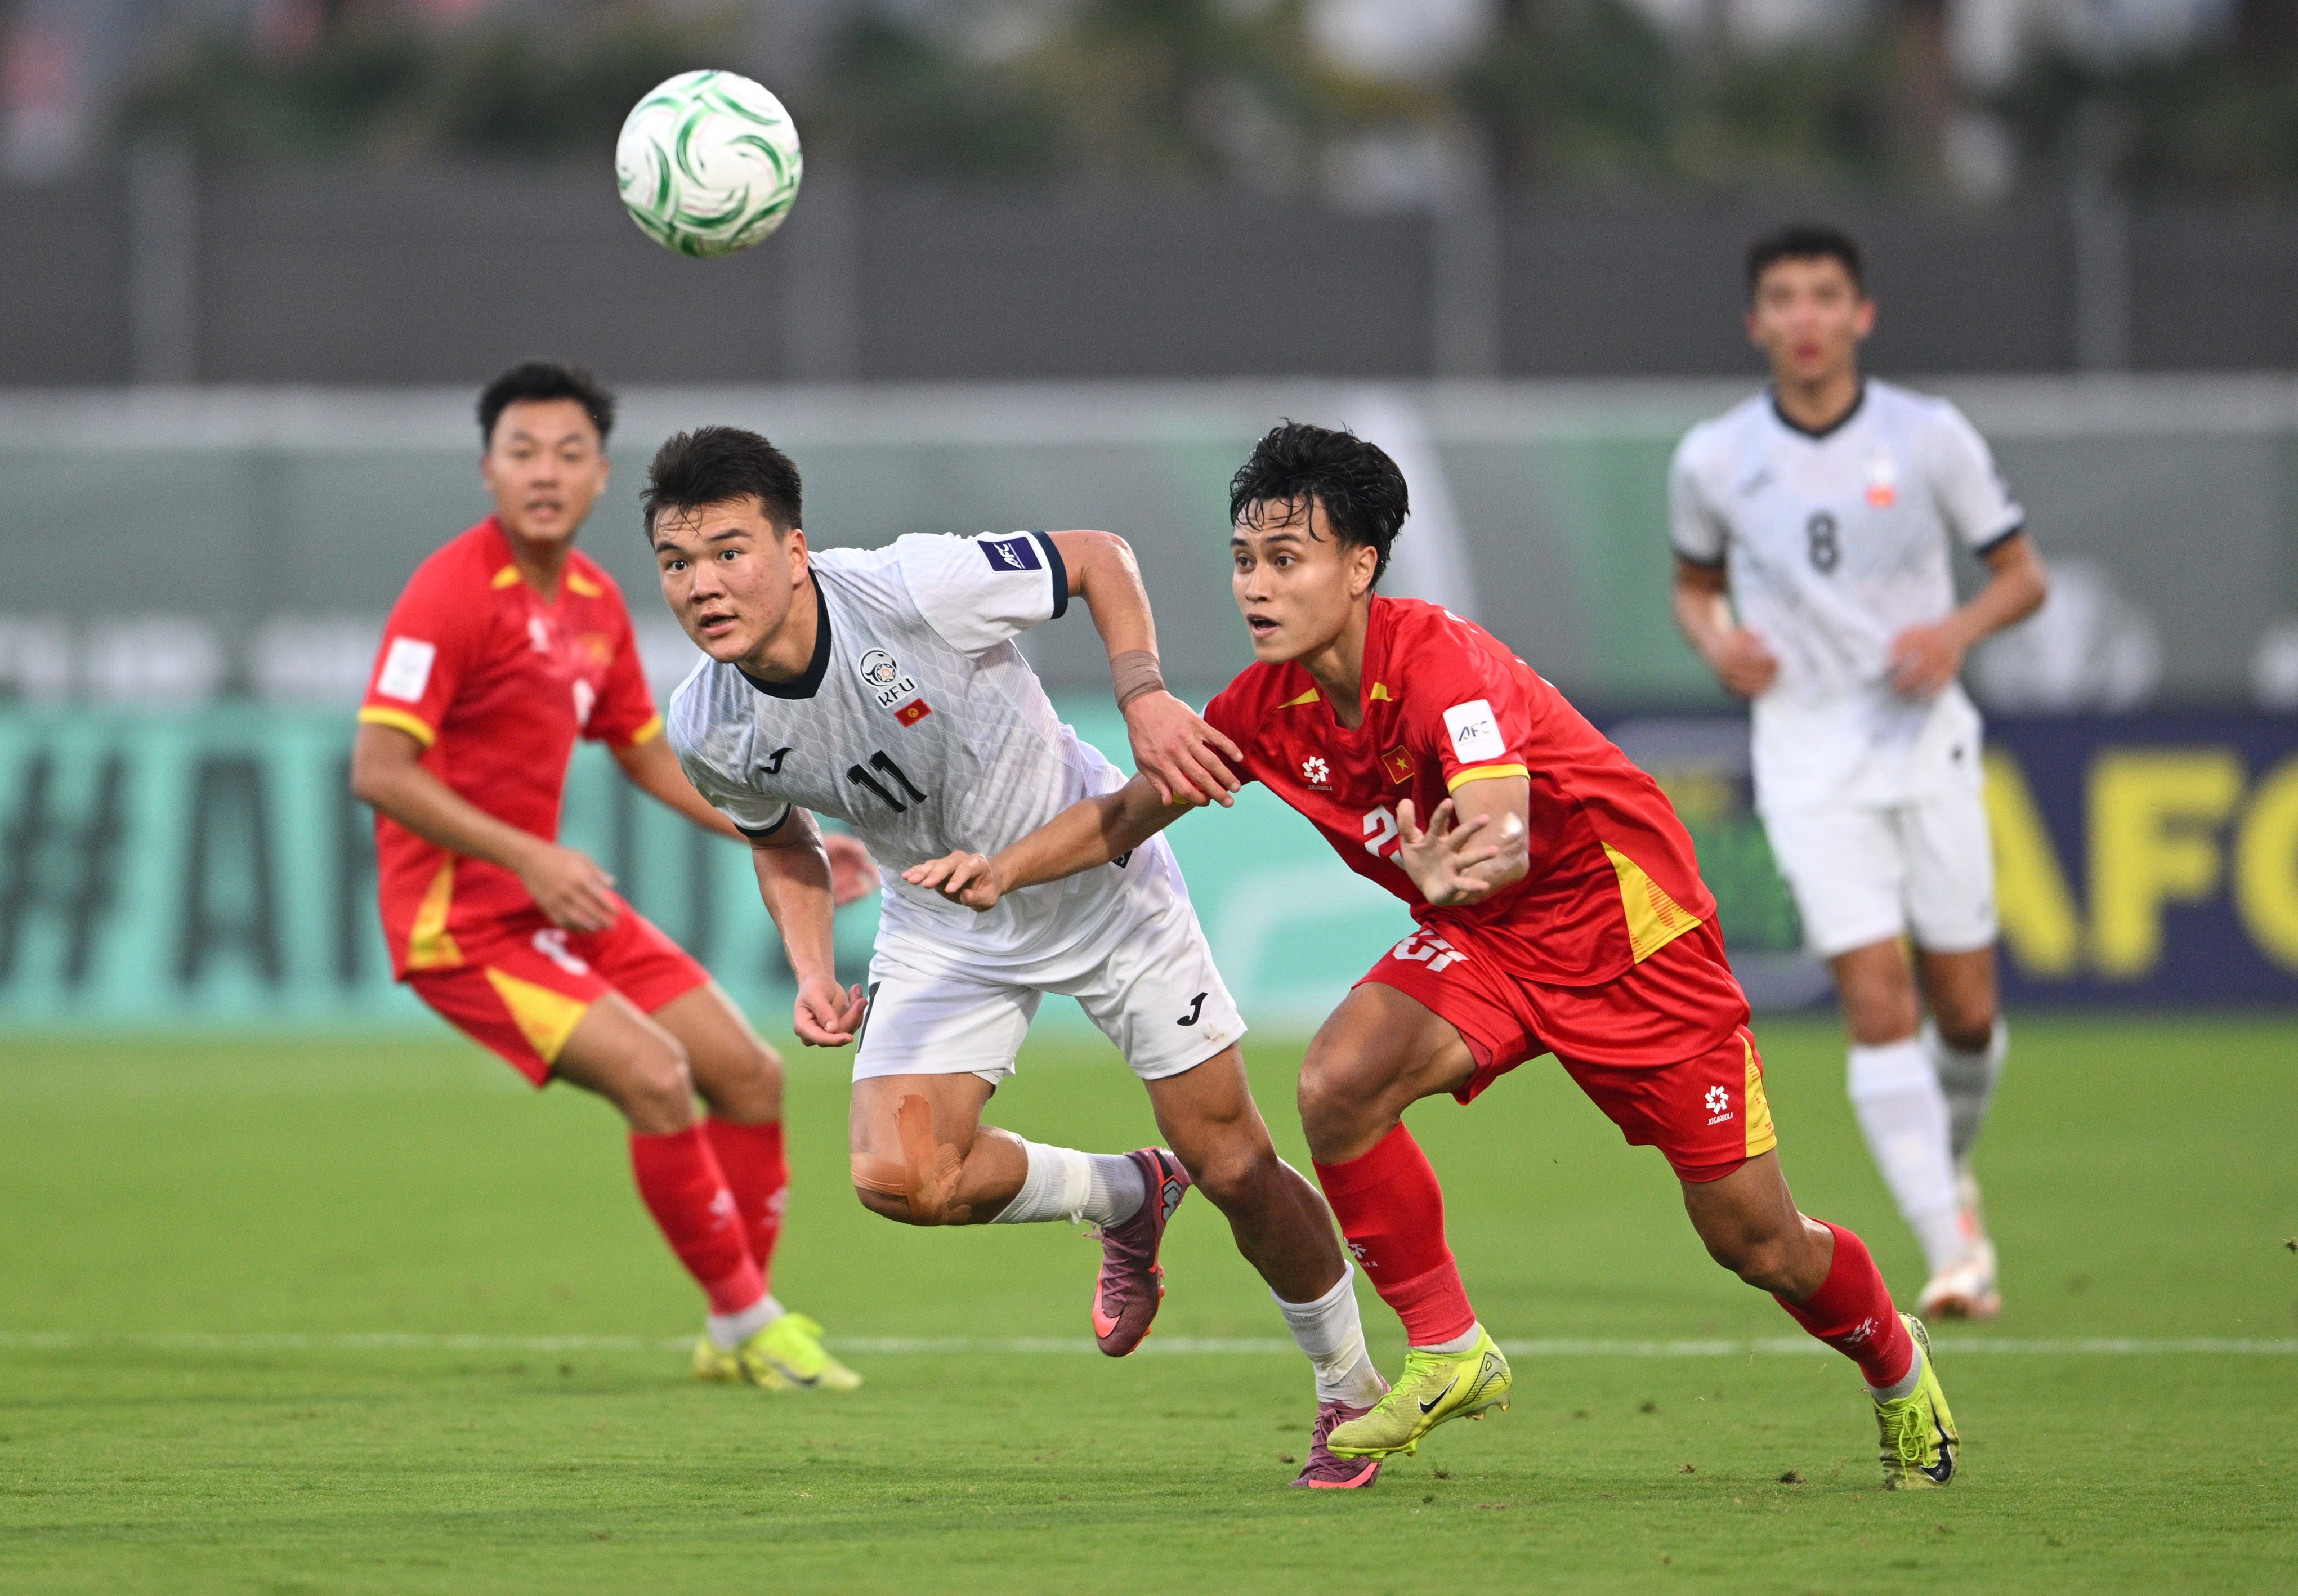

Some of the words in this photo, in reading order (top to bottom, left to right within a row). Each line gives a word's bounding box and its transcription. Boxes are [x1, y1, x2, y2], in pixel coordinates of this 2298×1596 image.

[993, 543, 1022, 569] AFC
[1805, 509, 1841, 575] 8
[878, 678, 915, 707] KFU
[846, 750, 928, 814] 11
[1707, 1111, 1733, 1125] JOGARBOLA
